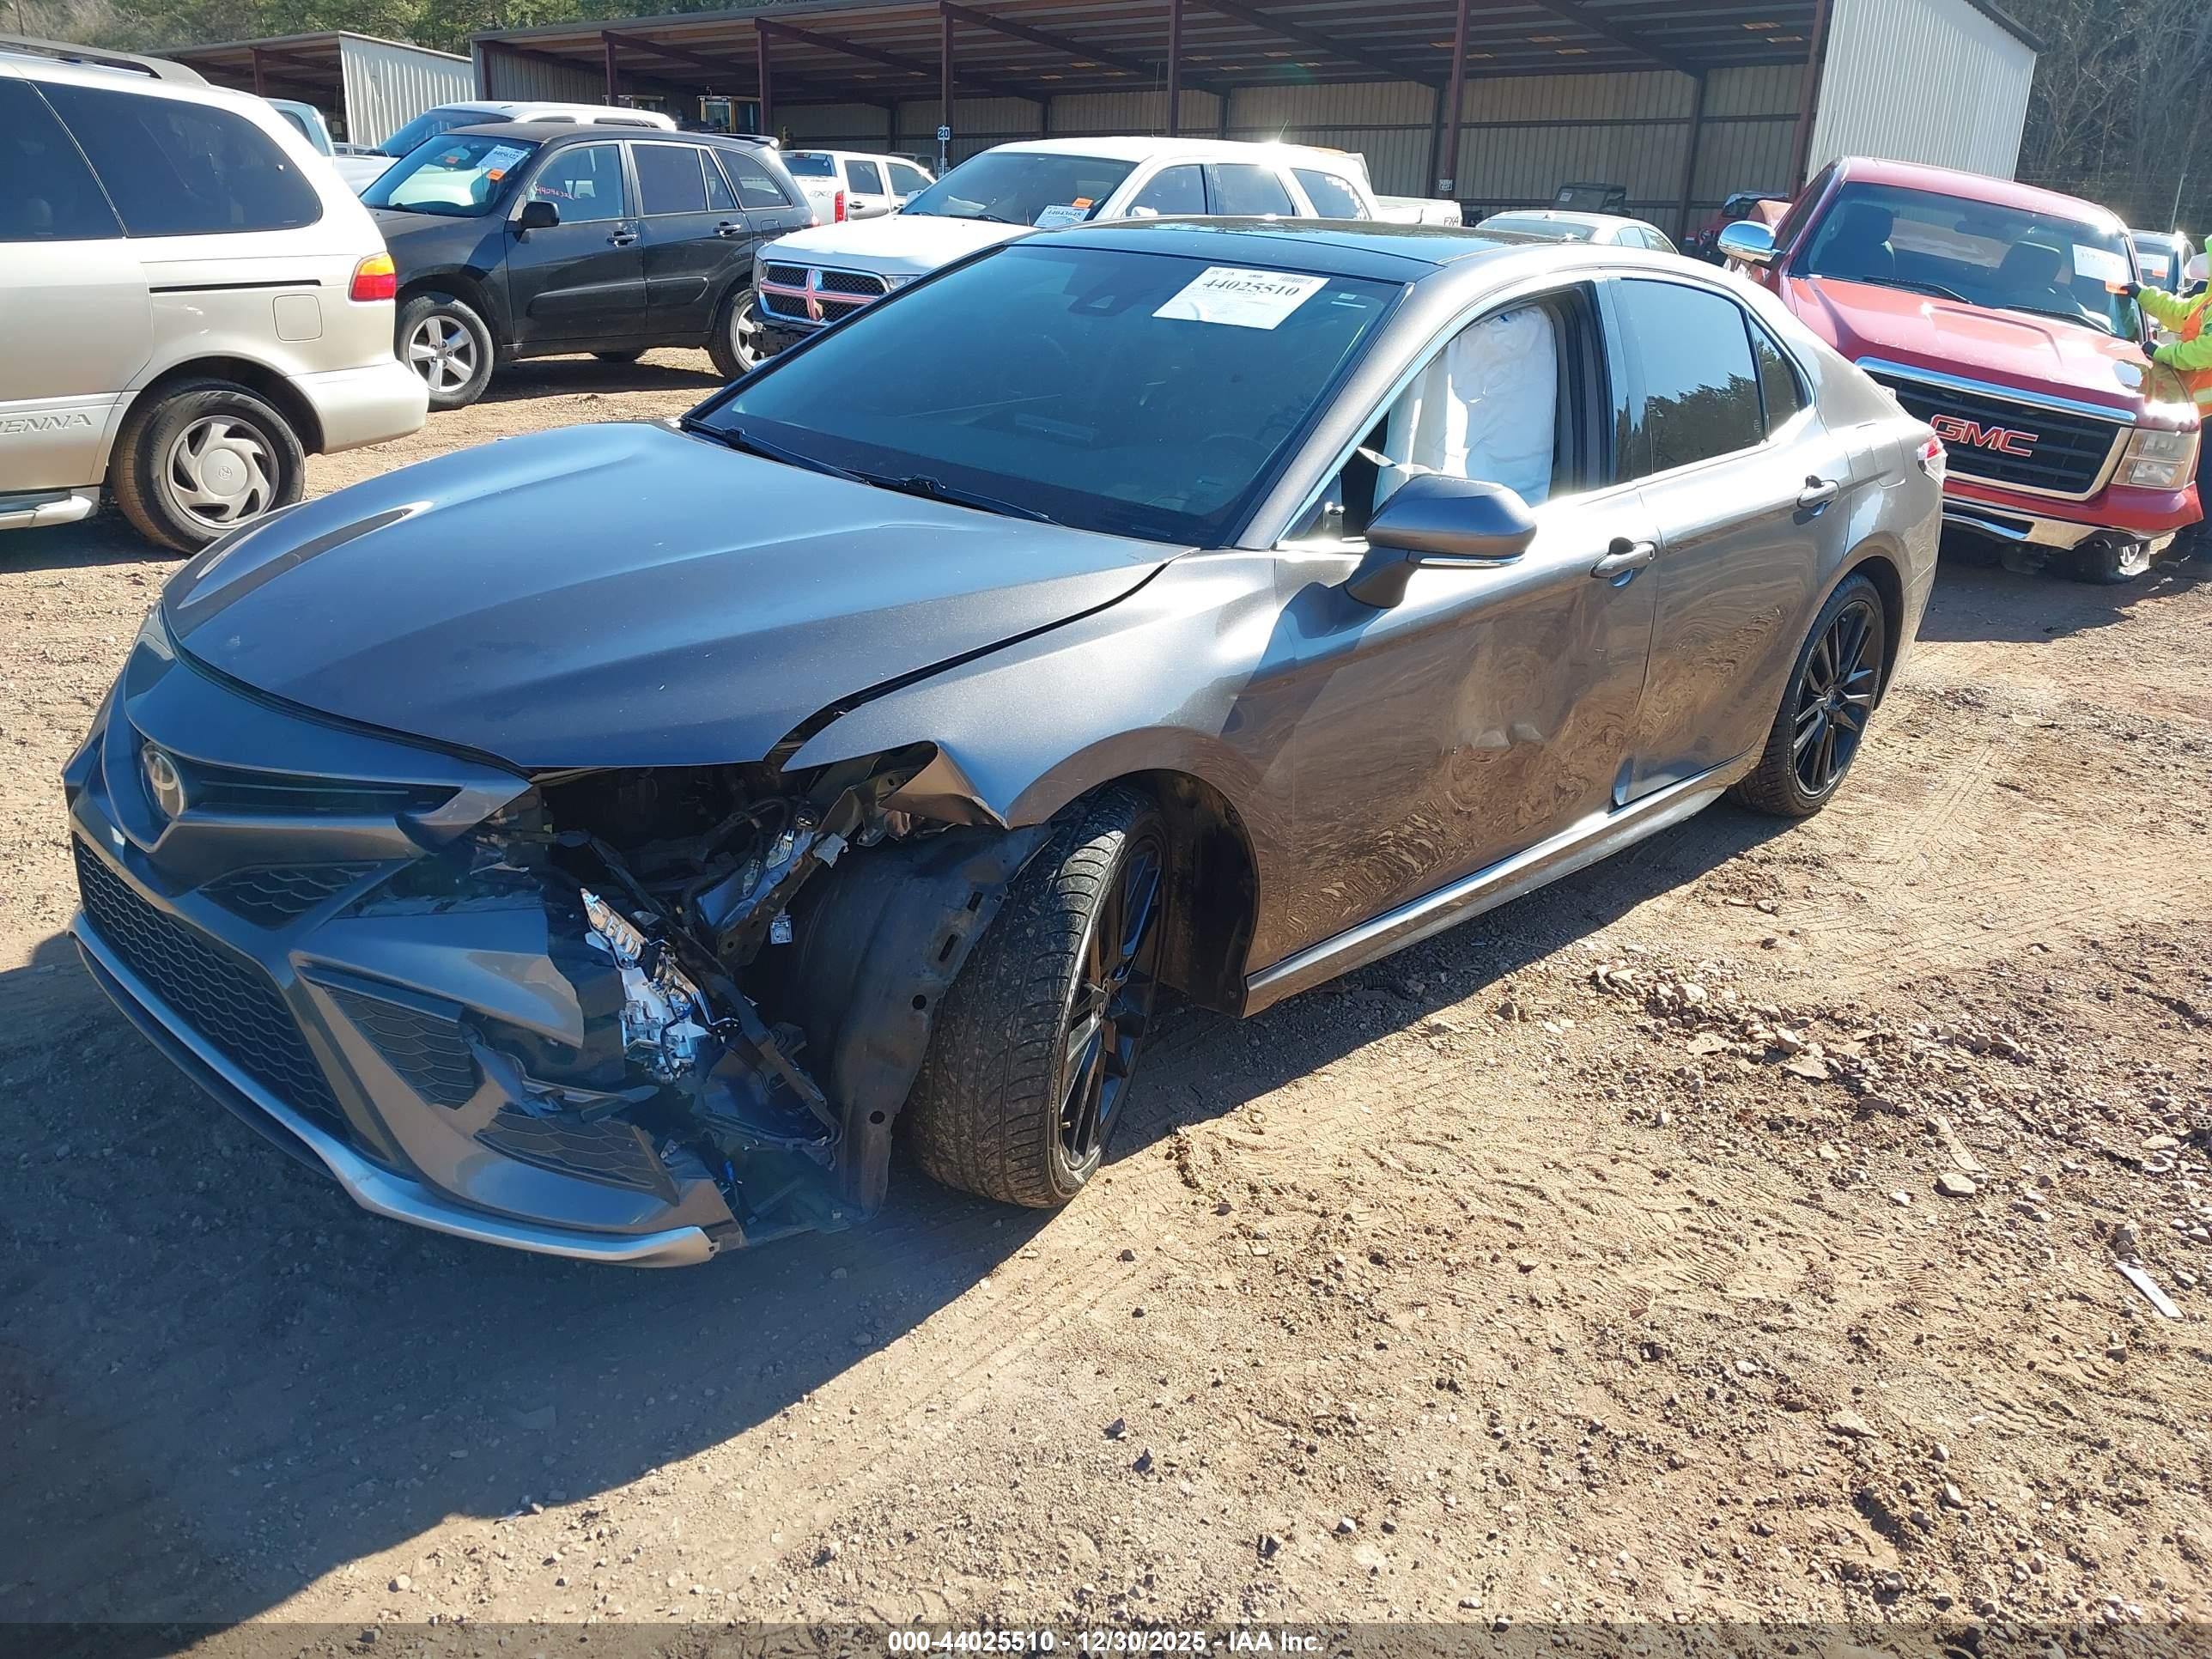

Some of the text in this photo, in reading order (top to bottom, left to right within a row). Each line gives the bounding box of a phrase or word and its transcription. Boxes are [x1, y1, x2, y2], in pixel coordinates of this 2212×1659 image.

[939, 129, 949, 138] 20
[1444, 216, 1459, 228] FX4
[1202, 278, 1300, 296] 44025510
[1929, 413, 2039, 458] GMC
